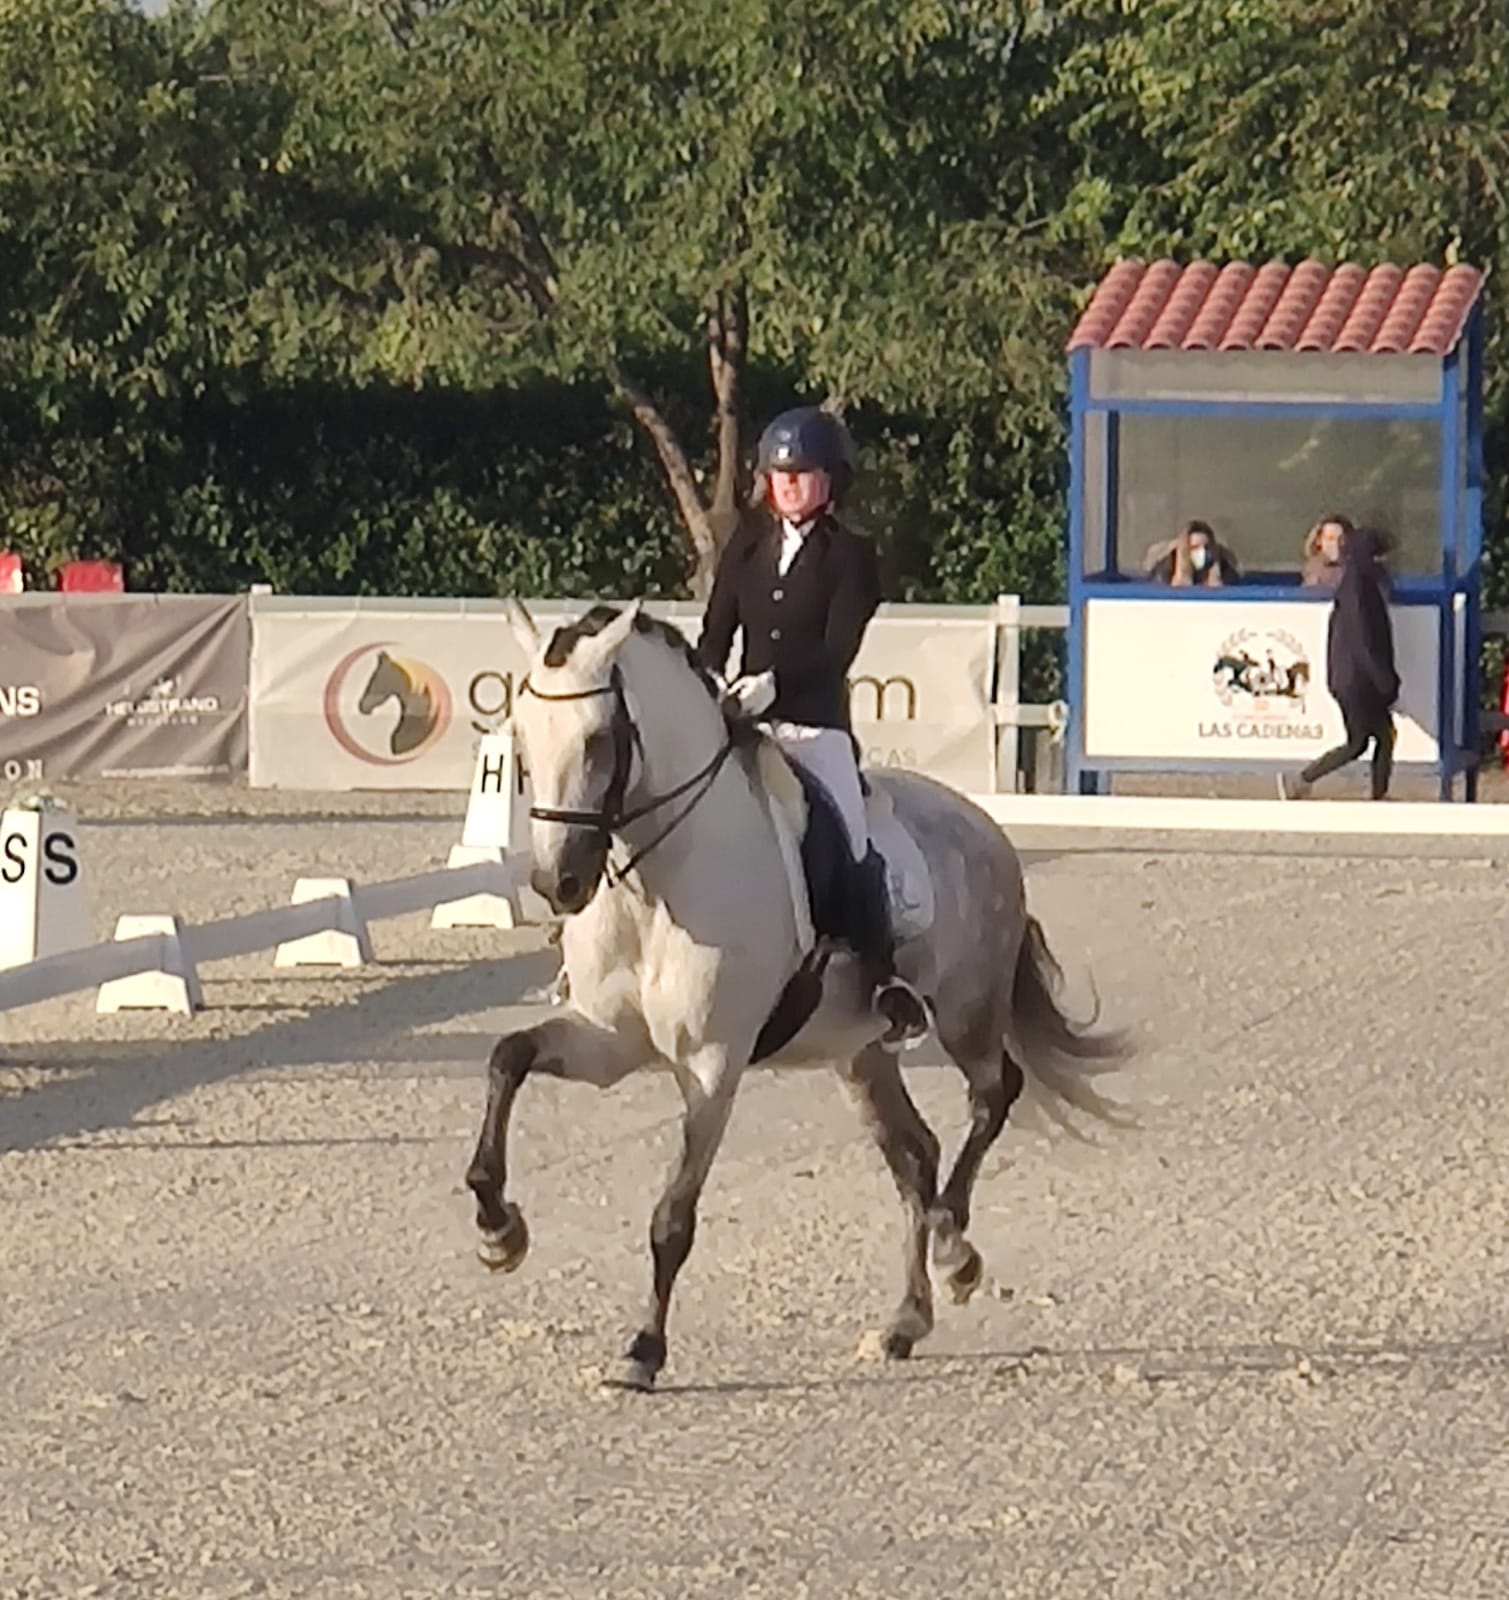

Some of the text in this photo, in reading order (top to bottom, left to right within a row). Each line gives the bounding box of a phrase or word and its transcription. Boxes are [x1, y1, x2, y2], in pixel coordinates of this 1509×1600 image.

[1198, 722, 1232, 738] LAS
[481, 754, 504, 793] H
[2, 832, 28, 883] S
[44, 832, 78, 885] S
